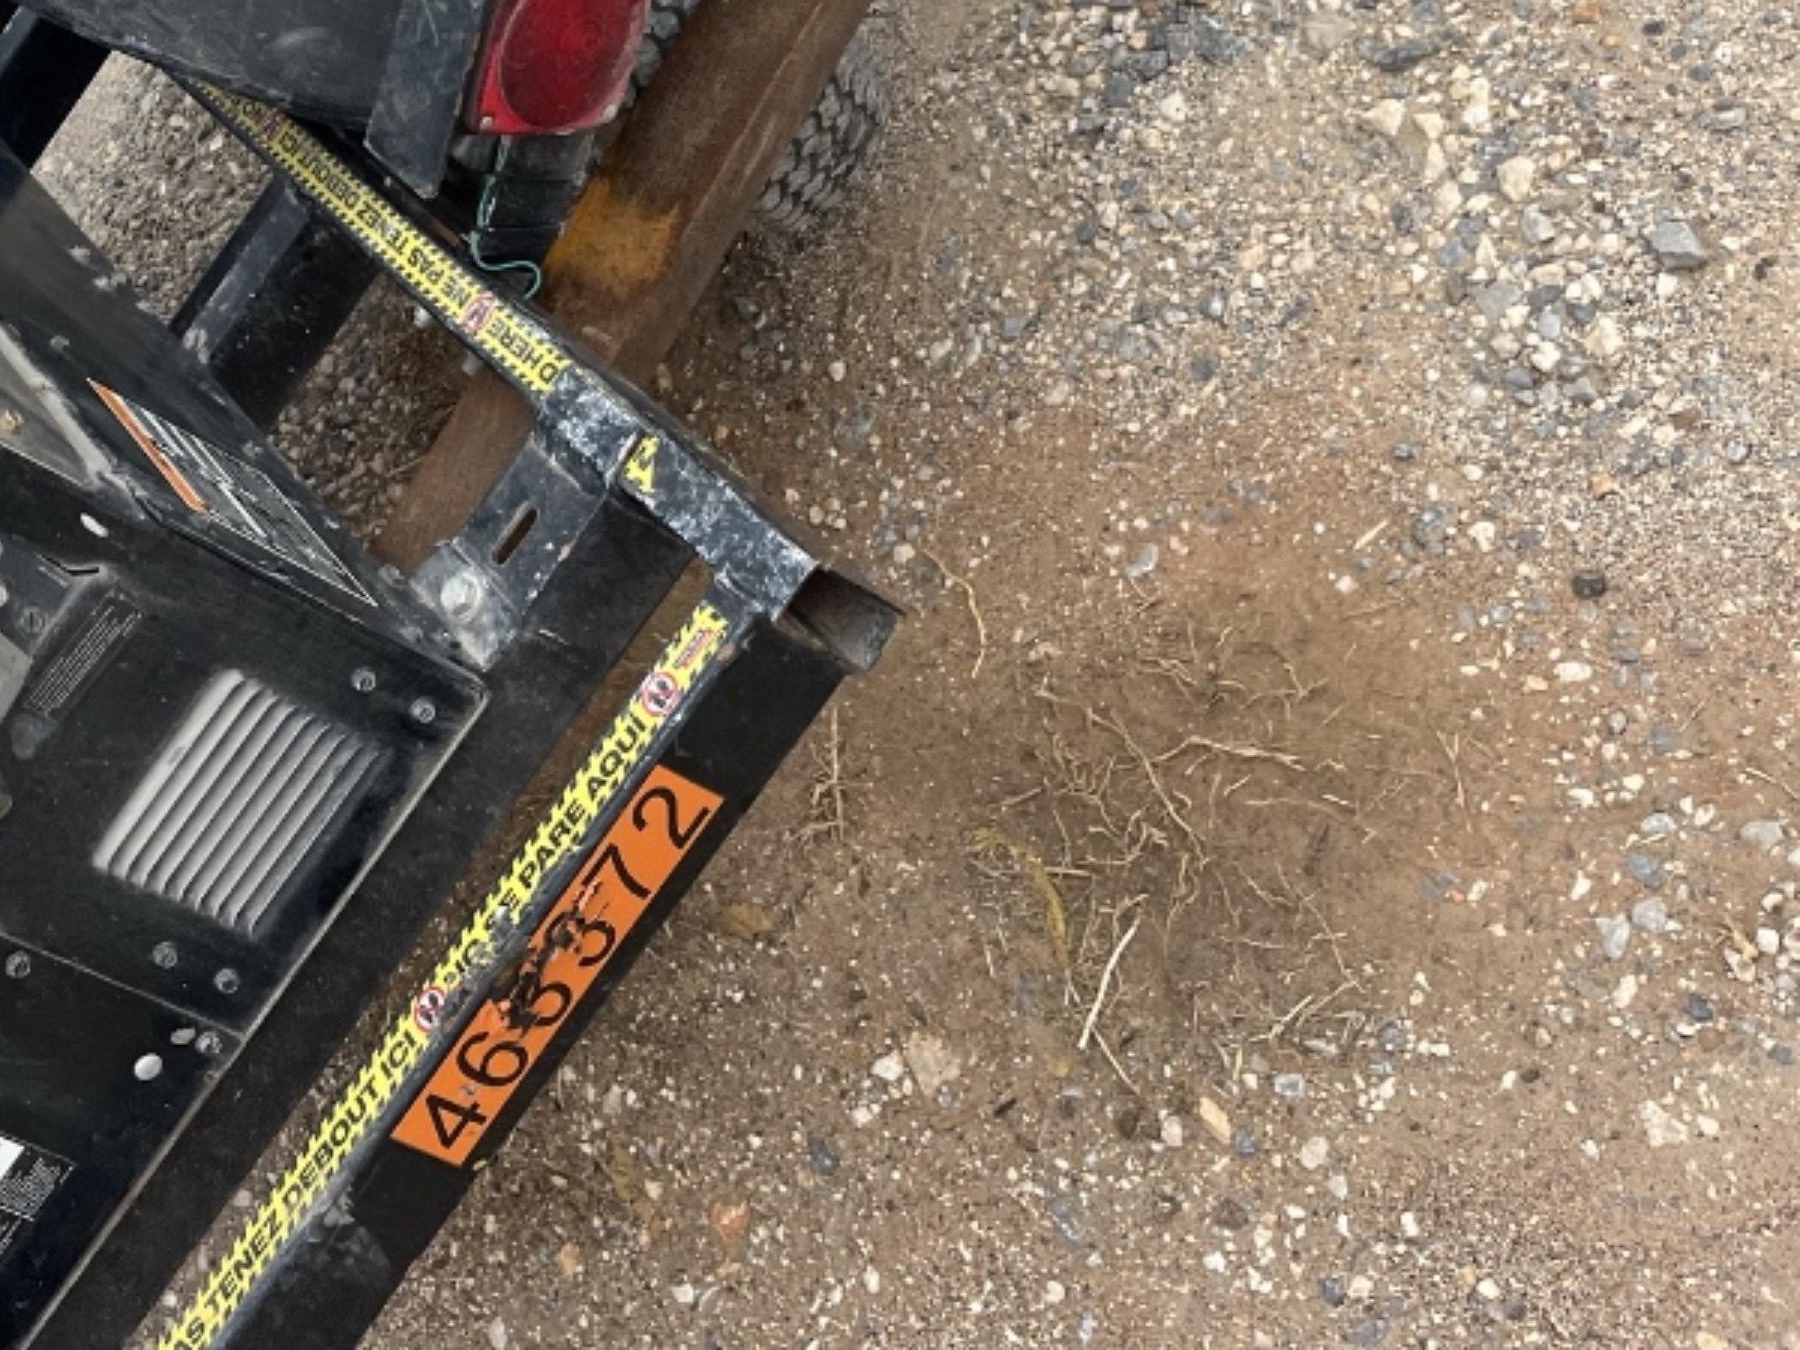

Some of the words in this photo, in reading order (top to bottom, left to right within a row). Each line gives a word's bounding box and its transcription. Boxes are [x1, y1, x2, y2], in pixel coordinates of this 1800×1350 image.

[520, 800, 585, 891] PARE
[586, 714, 647, 802] AQUÍ
[210, 1213, 282, 1313] TENEZ
[282, 1082, 380, 1207] DEBOUT
[380, 1028, 420, 1081] ICI
